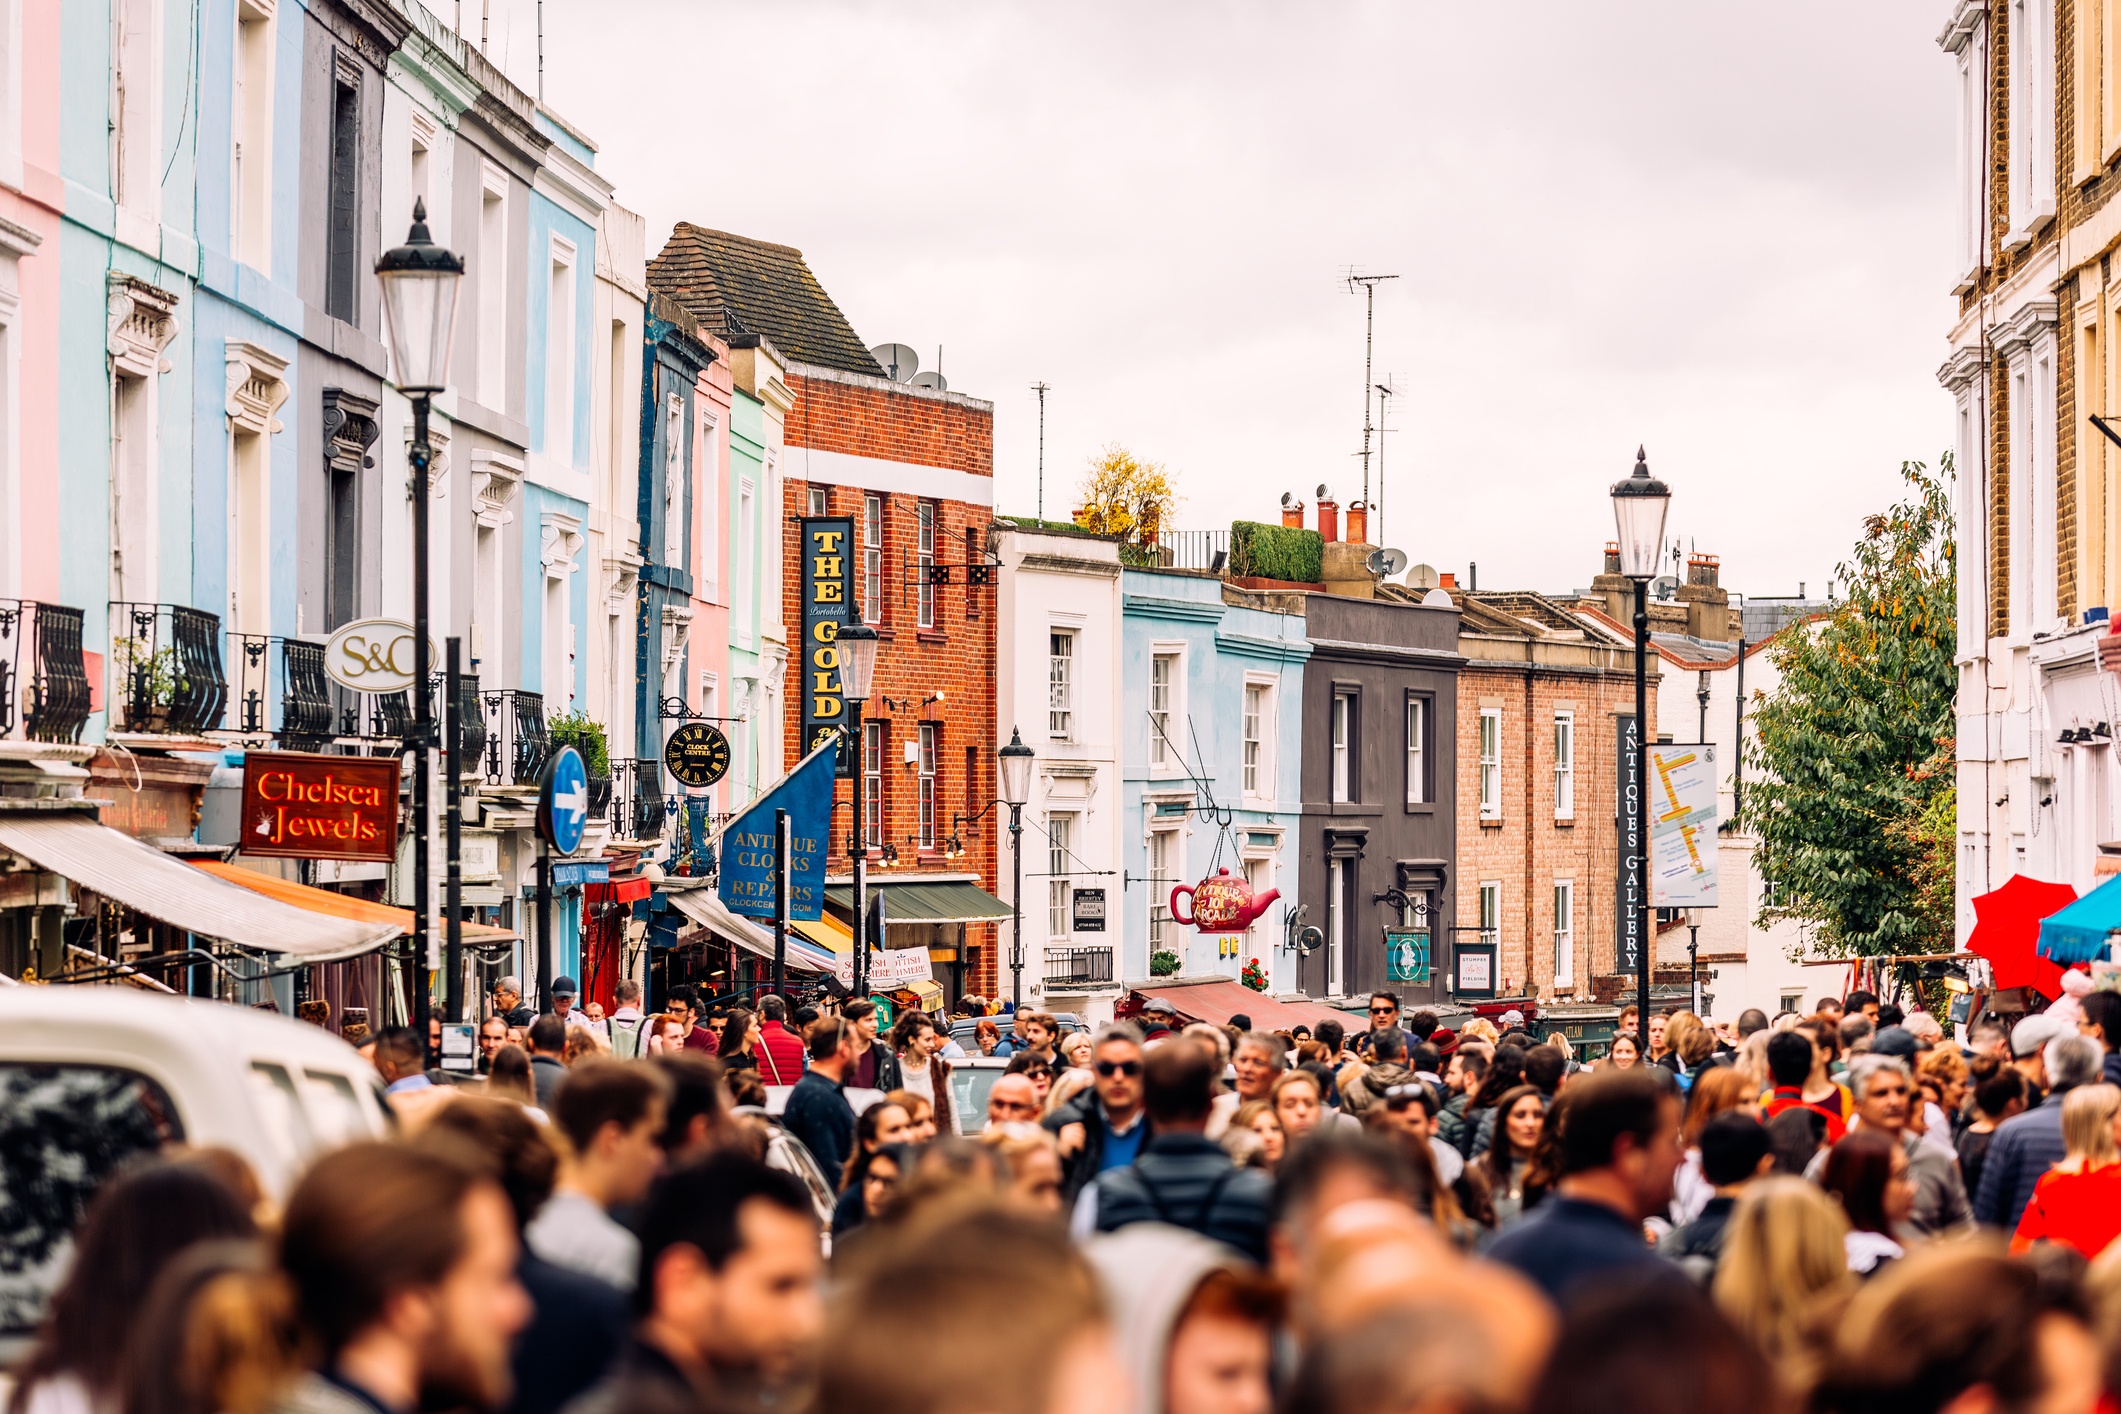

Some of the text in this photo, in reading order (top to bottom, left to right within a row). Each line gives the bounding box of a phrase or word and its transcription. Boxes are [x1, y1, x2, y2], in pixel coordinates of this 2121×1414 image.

[813, 531, 843, 603] THE
[810, 606, 846, 616] Portobello
[813, 620, 843, 718] GOLD
[258, 771, 381, 807] Chelsea
[270, 806, 378, 844] Jewels
[734, 832, 817, 853] ANTIUE
[1625, 720, 1639, 967] ANTIQUES GALLERY
[738, 852, 809, 872] CLOKS
[732, 881, 812, 901] REPARS
[1193, 882, 1242, 903] ANTIQUE
[729, 898, 811, 913] CLOCKCEN.COM
[1194, 904, 1240, 921] ARCADE
[841, 968, 891, 979] CAMERE
[844, 959, 886, 970] SCISH
[896, 965, 927, 976] HMERE
[1565, 1025, 1583, 1039] ATLAM
